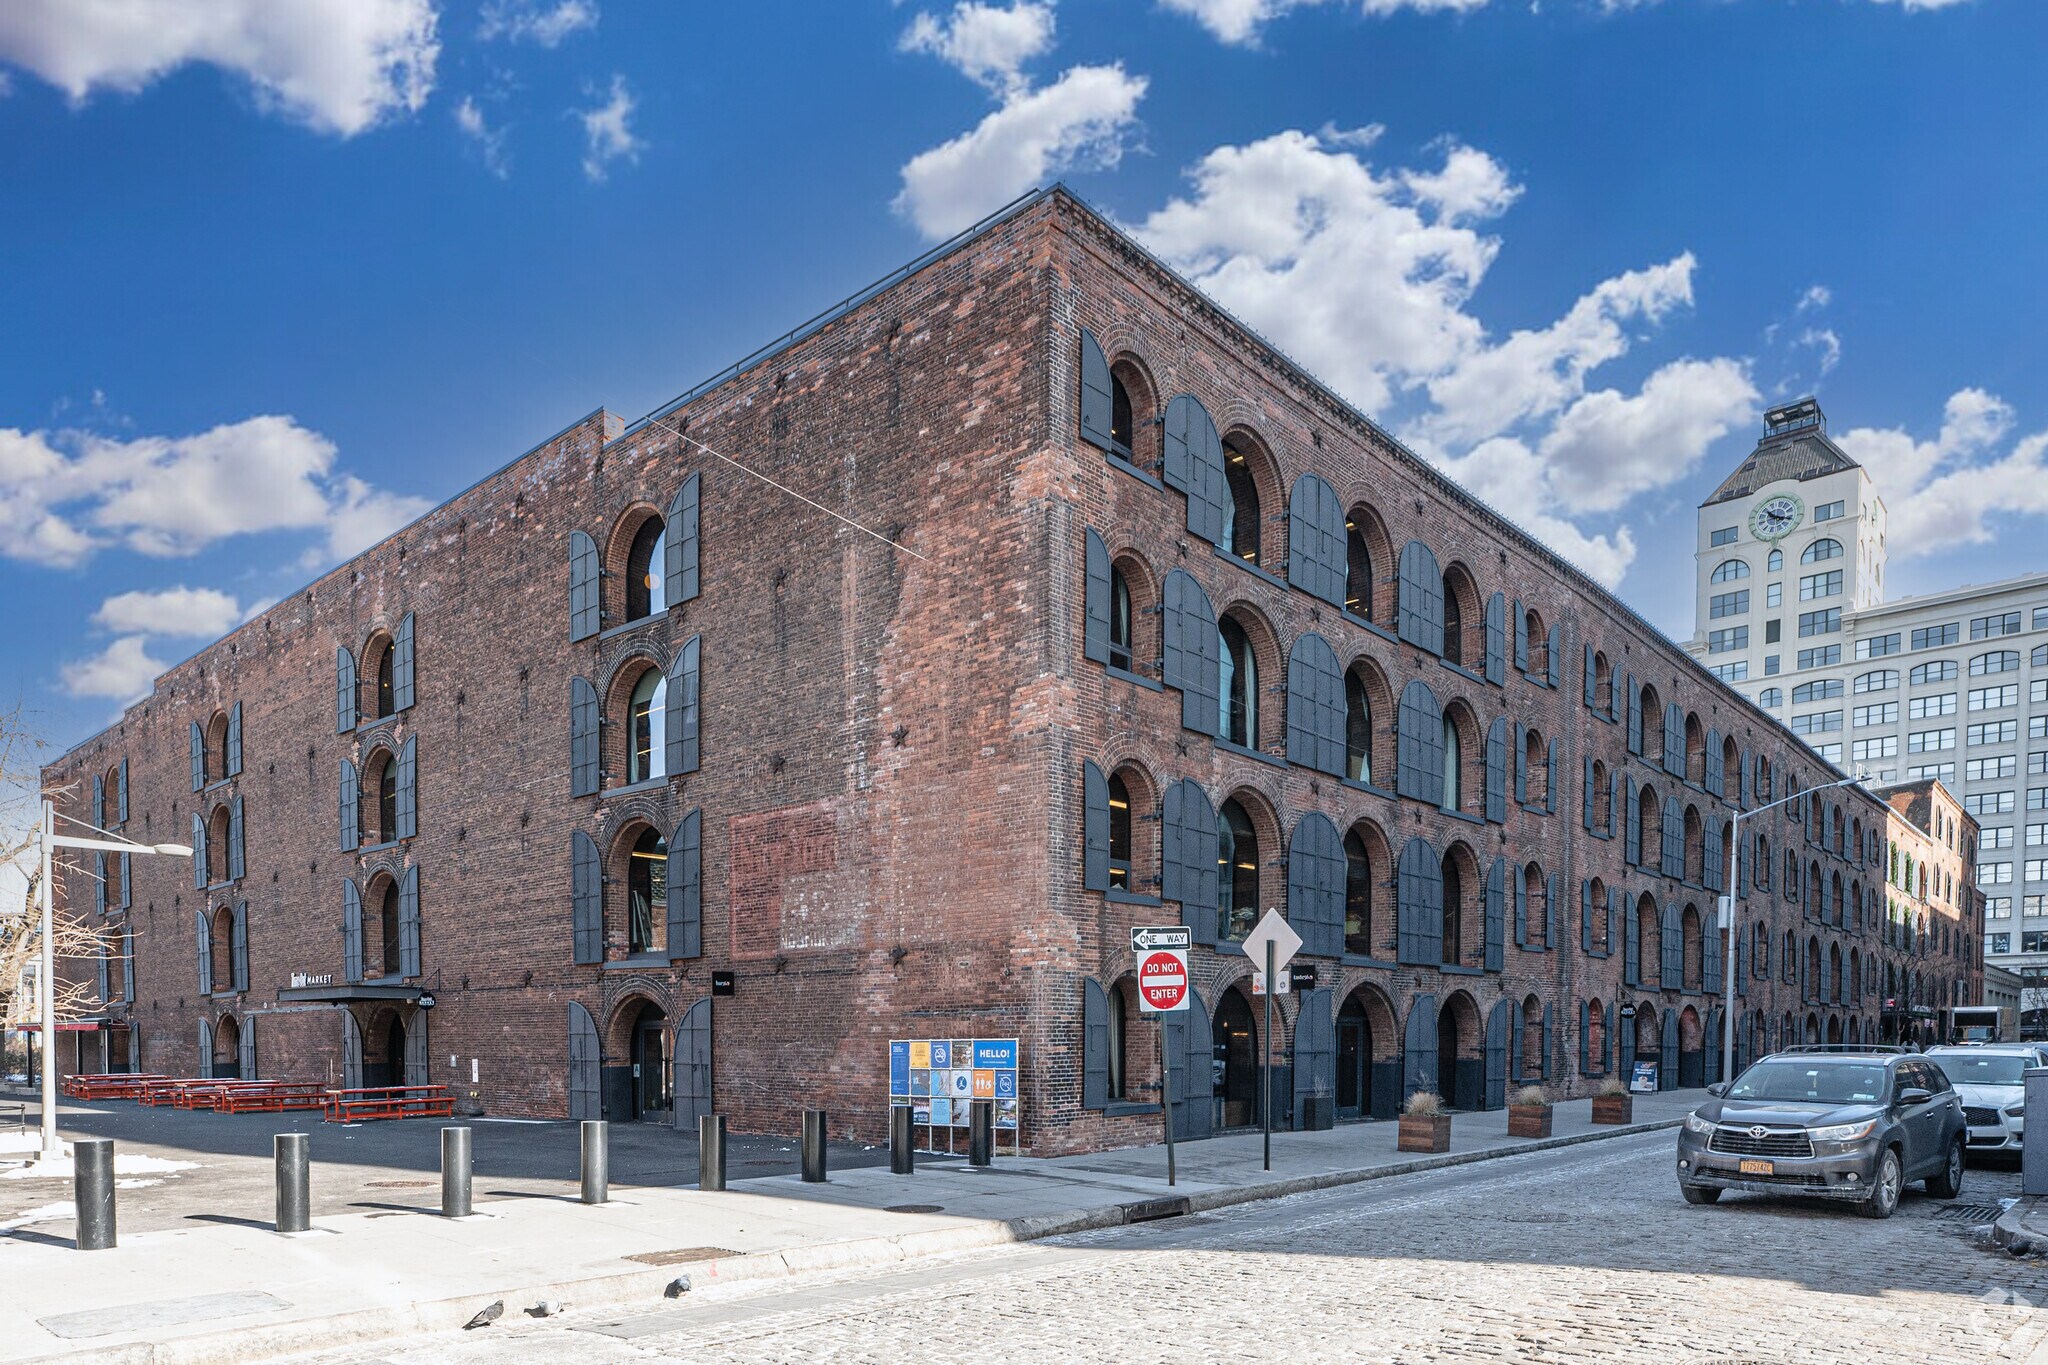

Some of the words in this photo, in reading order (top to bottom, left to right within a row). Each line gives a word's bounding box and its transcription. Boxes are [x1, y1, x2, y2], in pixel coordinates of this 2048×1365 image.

[1140, 935, 1157, 944] ONE
[1167, 934, 1185, 943] WAY
[1147, 964, 1159, 973] DO
[1162, 963, 1178, 972] NOT
[307, 975, 332, 984] MARKET
[1151, 988, 1178, 999] ENTER
[980, 1049, 1010, 1058] HELLO!
